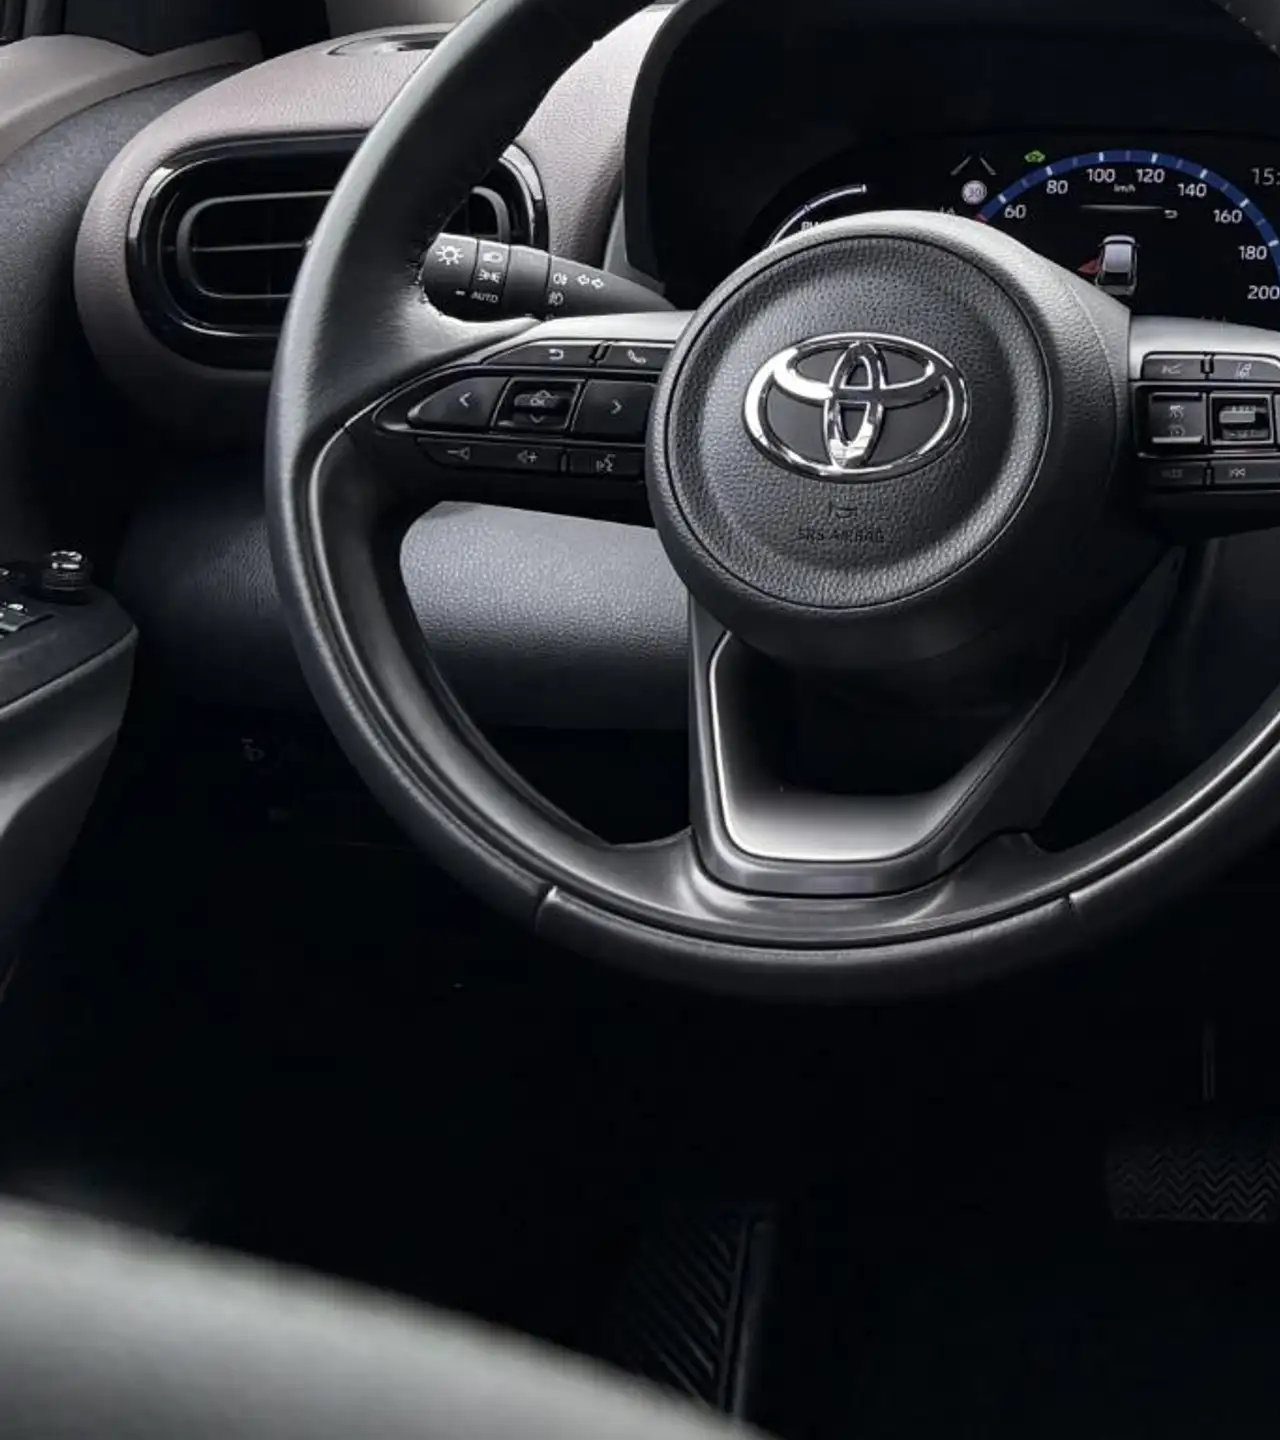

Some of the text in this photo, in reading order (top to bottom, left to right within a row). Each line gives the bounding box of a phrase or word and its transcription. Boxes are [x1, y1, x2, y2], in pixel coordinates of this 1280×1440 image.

[1086, 168, 1116, 183] 100
[1136, 168, 1165, 183] 120
[1046, 180, 1068, 195] 80
[1177, 183, 1207, 198] 140
[1004, 205, 1026, 219] 60
[1213, 209, 1243, 224] 160
[1238, 245, 1267, 260] 180
[470, 291, 498, 303] AUTO
[1247, 286, 1280, 300] 200
